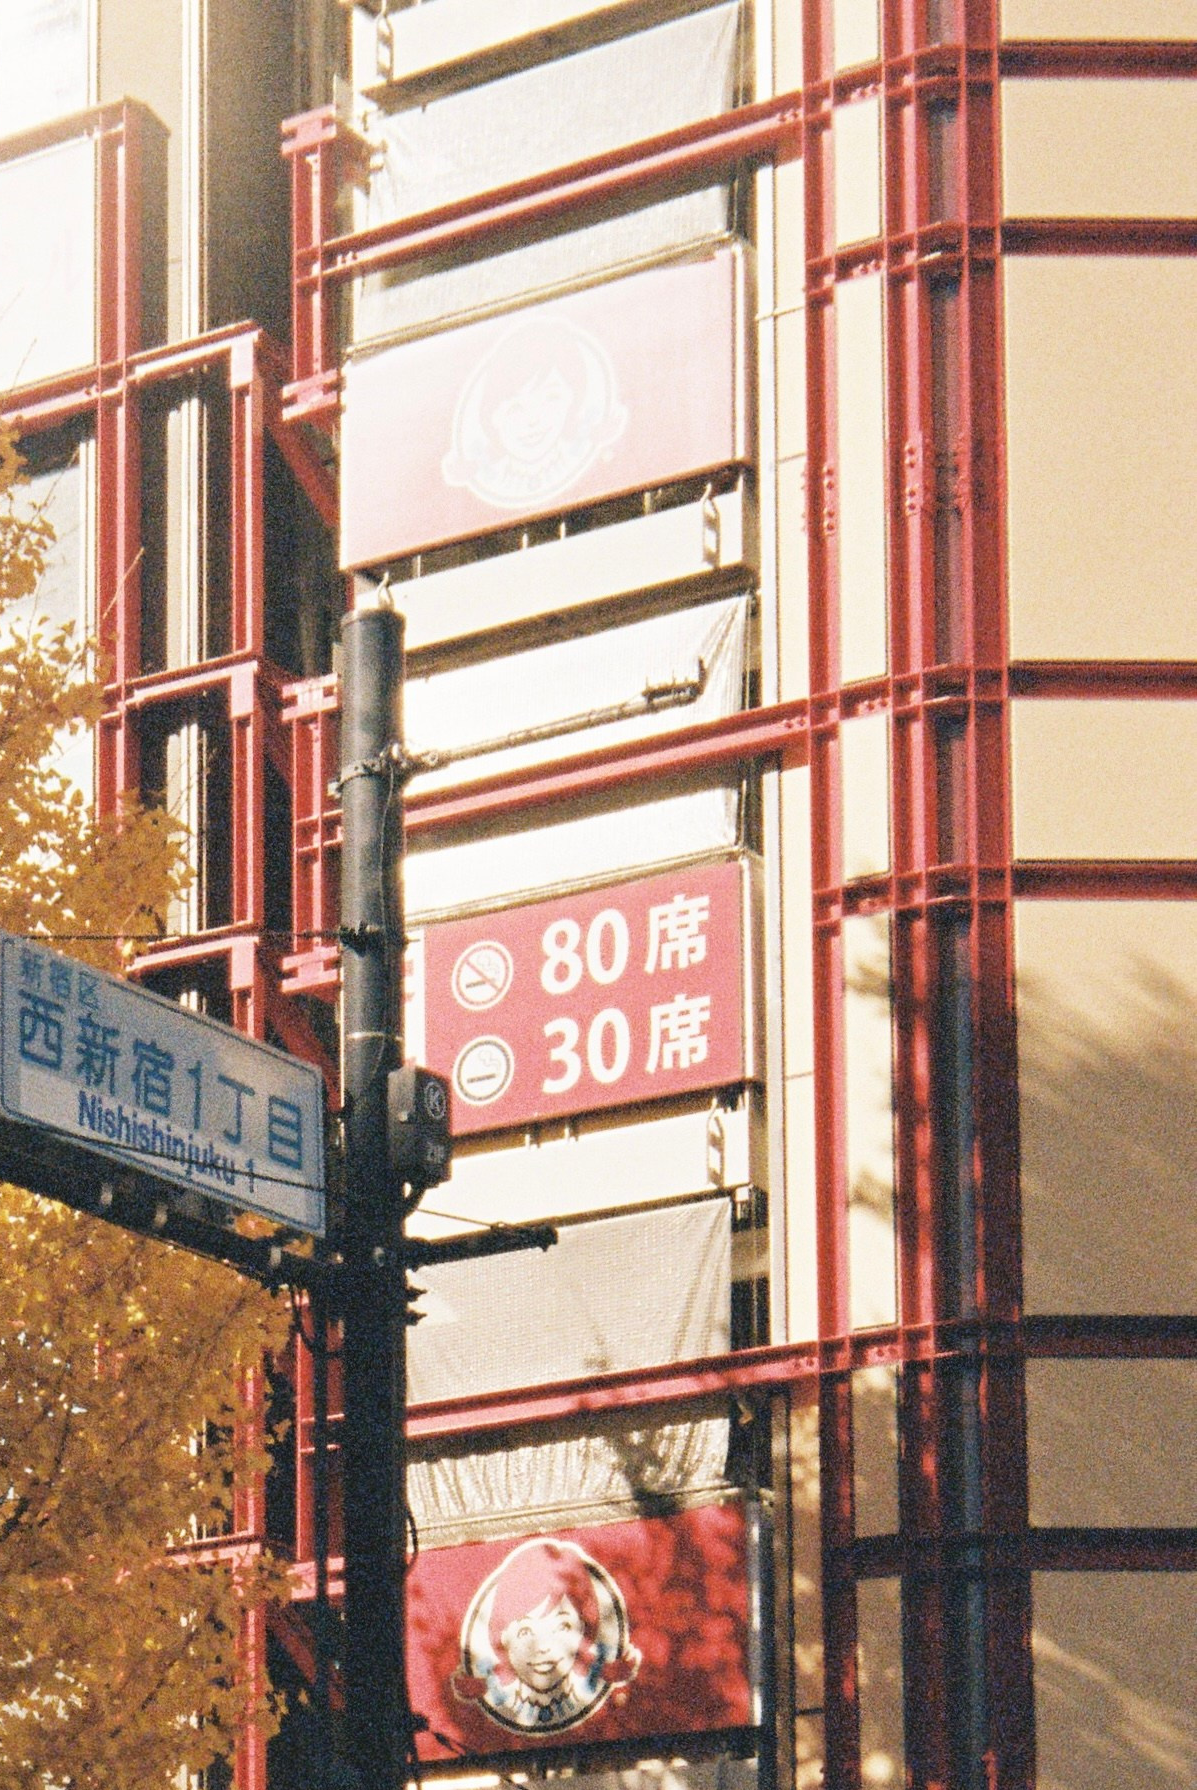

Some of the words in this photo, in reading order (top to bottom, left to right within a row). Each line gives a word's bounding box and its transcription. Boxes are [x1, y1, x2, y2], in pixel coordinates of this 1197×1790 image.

[20, 949, 102, 1010] 新宿区
[540, 894, 710, 994] 80席
[19, 988, 303, 1171] 西新宿1丁目
[541, 994, 711, 1094] 30席
[77, 1091, 237, 1185] Nishishinjuku
[246, 1158, 256, 1193] 1
